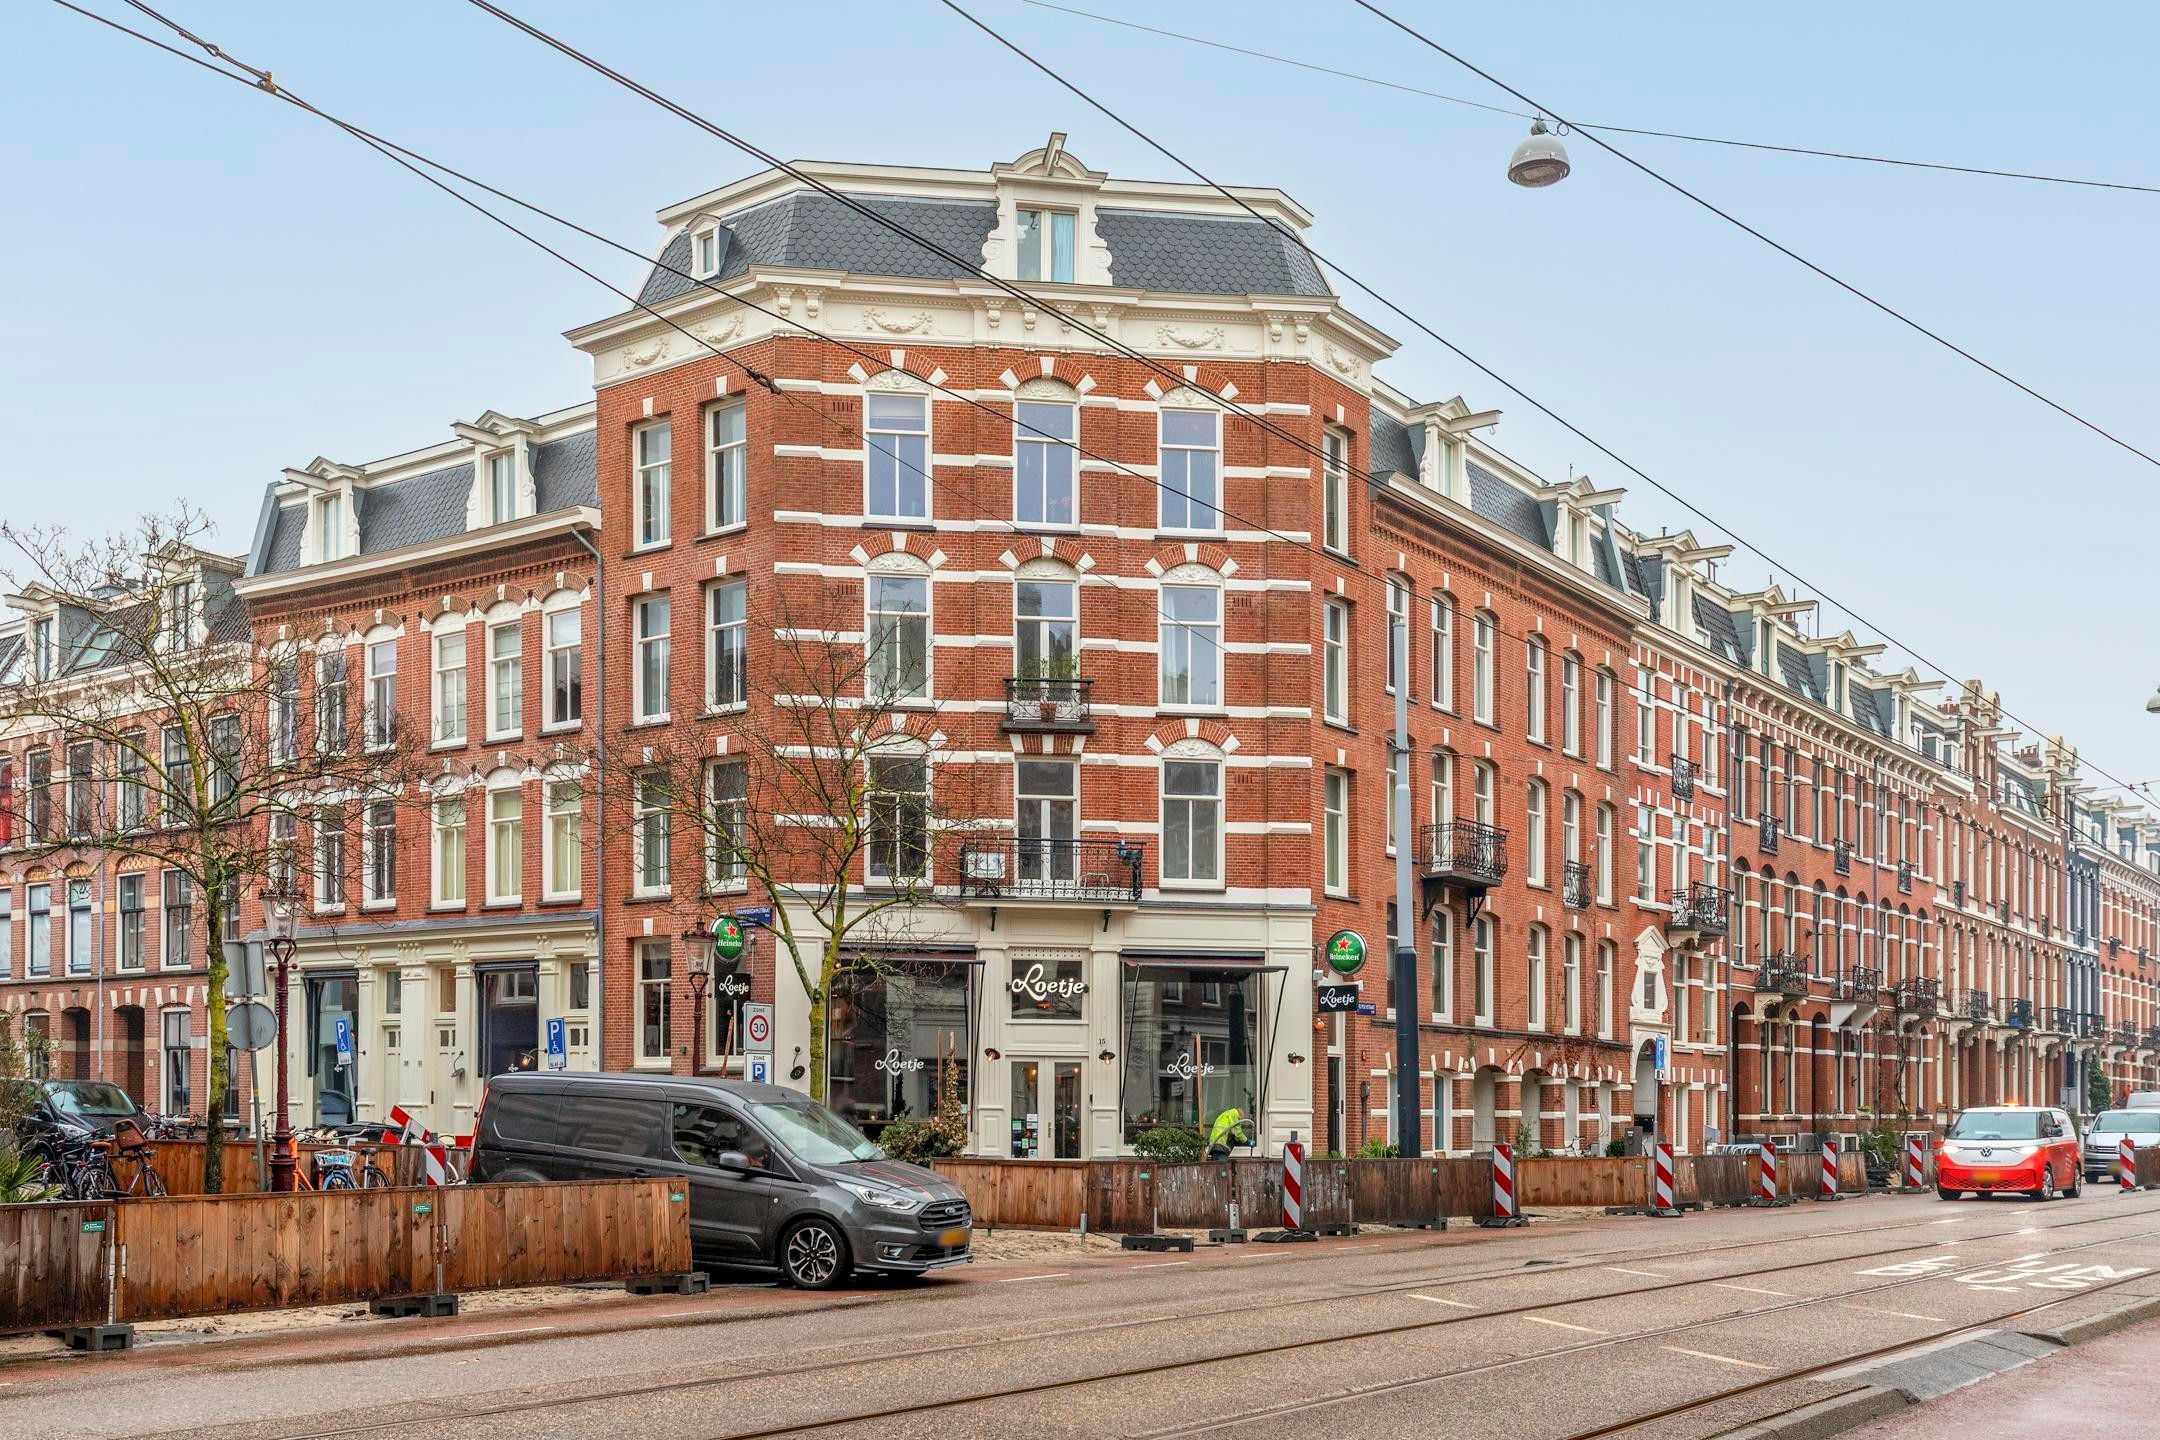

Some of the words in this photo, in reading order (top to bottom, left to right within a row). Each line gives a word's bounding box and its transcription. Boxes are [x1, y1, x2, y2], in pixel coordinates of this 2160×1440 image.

[1329, 953, 1360, 961] Heineken
[719, 974, 750, 996] Loetje
[1011, 963, 1084, 1001] Loetje
[1320, 988, 1355, 1008] Loetje
[337, 1022, 345, 1039] P
[550, 1022, 559, 1040] P
[752, 1023, 766, 1033] 30
[875, 1048, 924, 1076] Loetje
